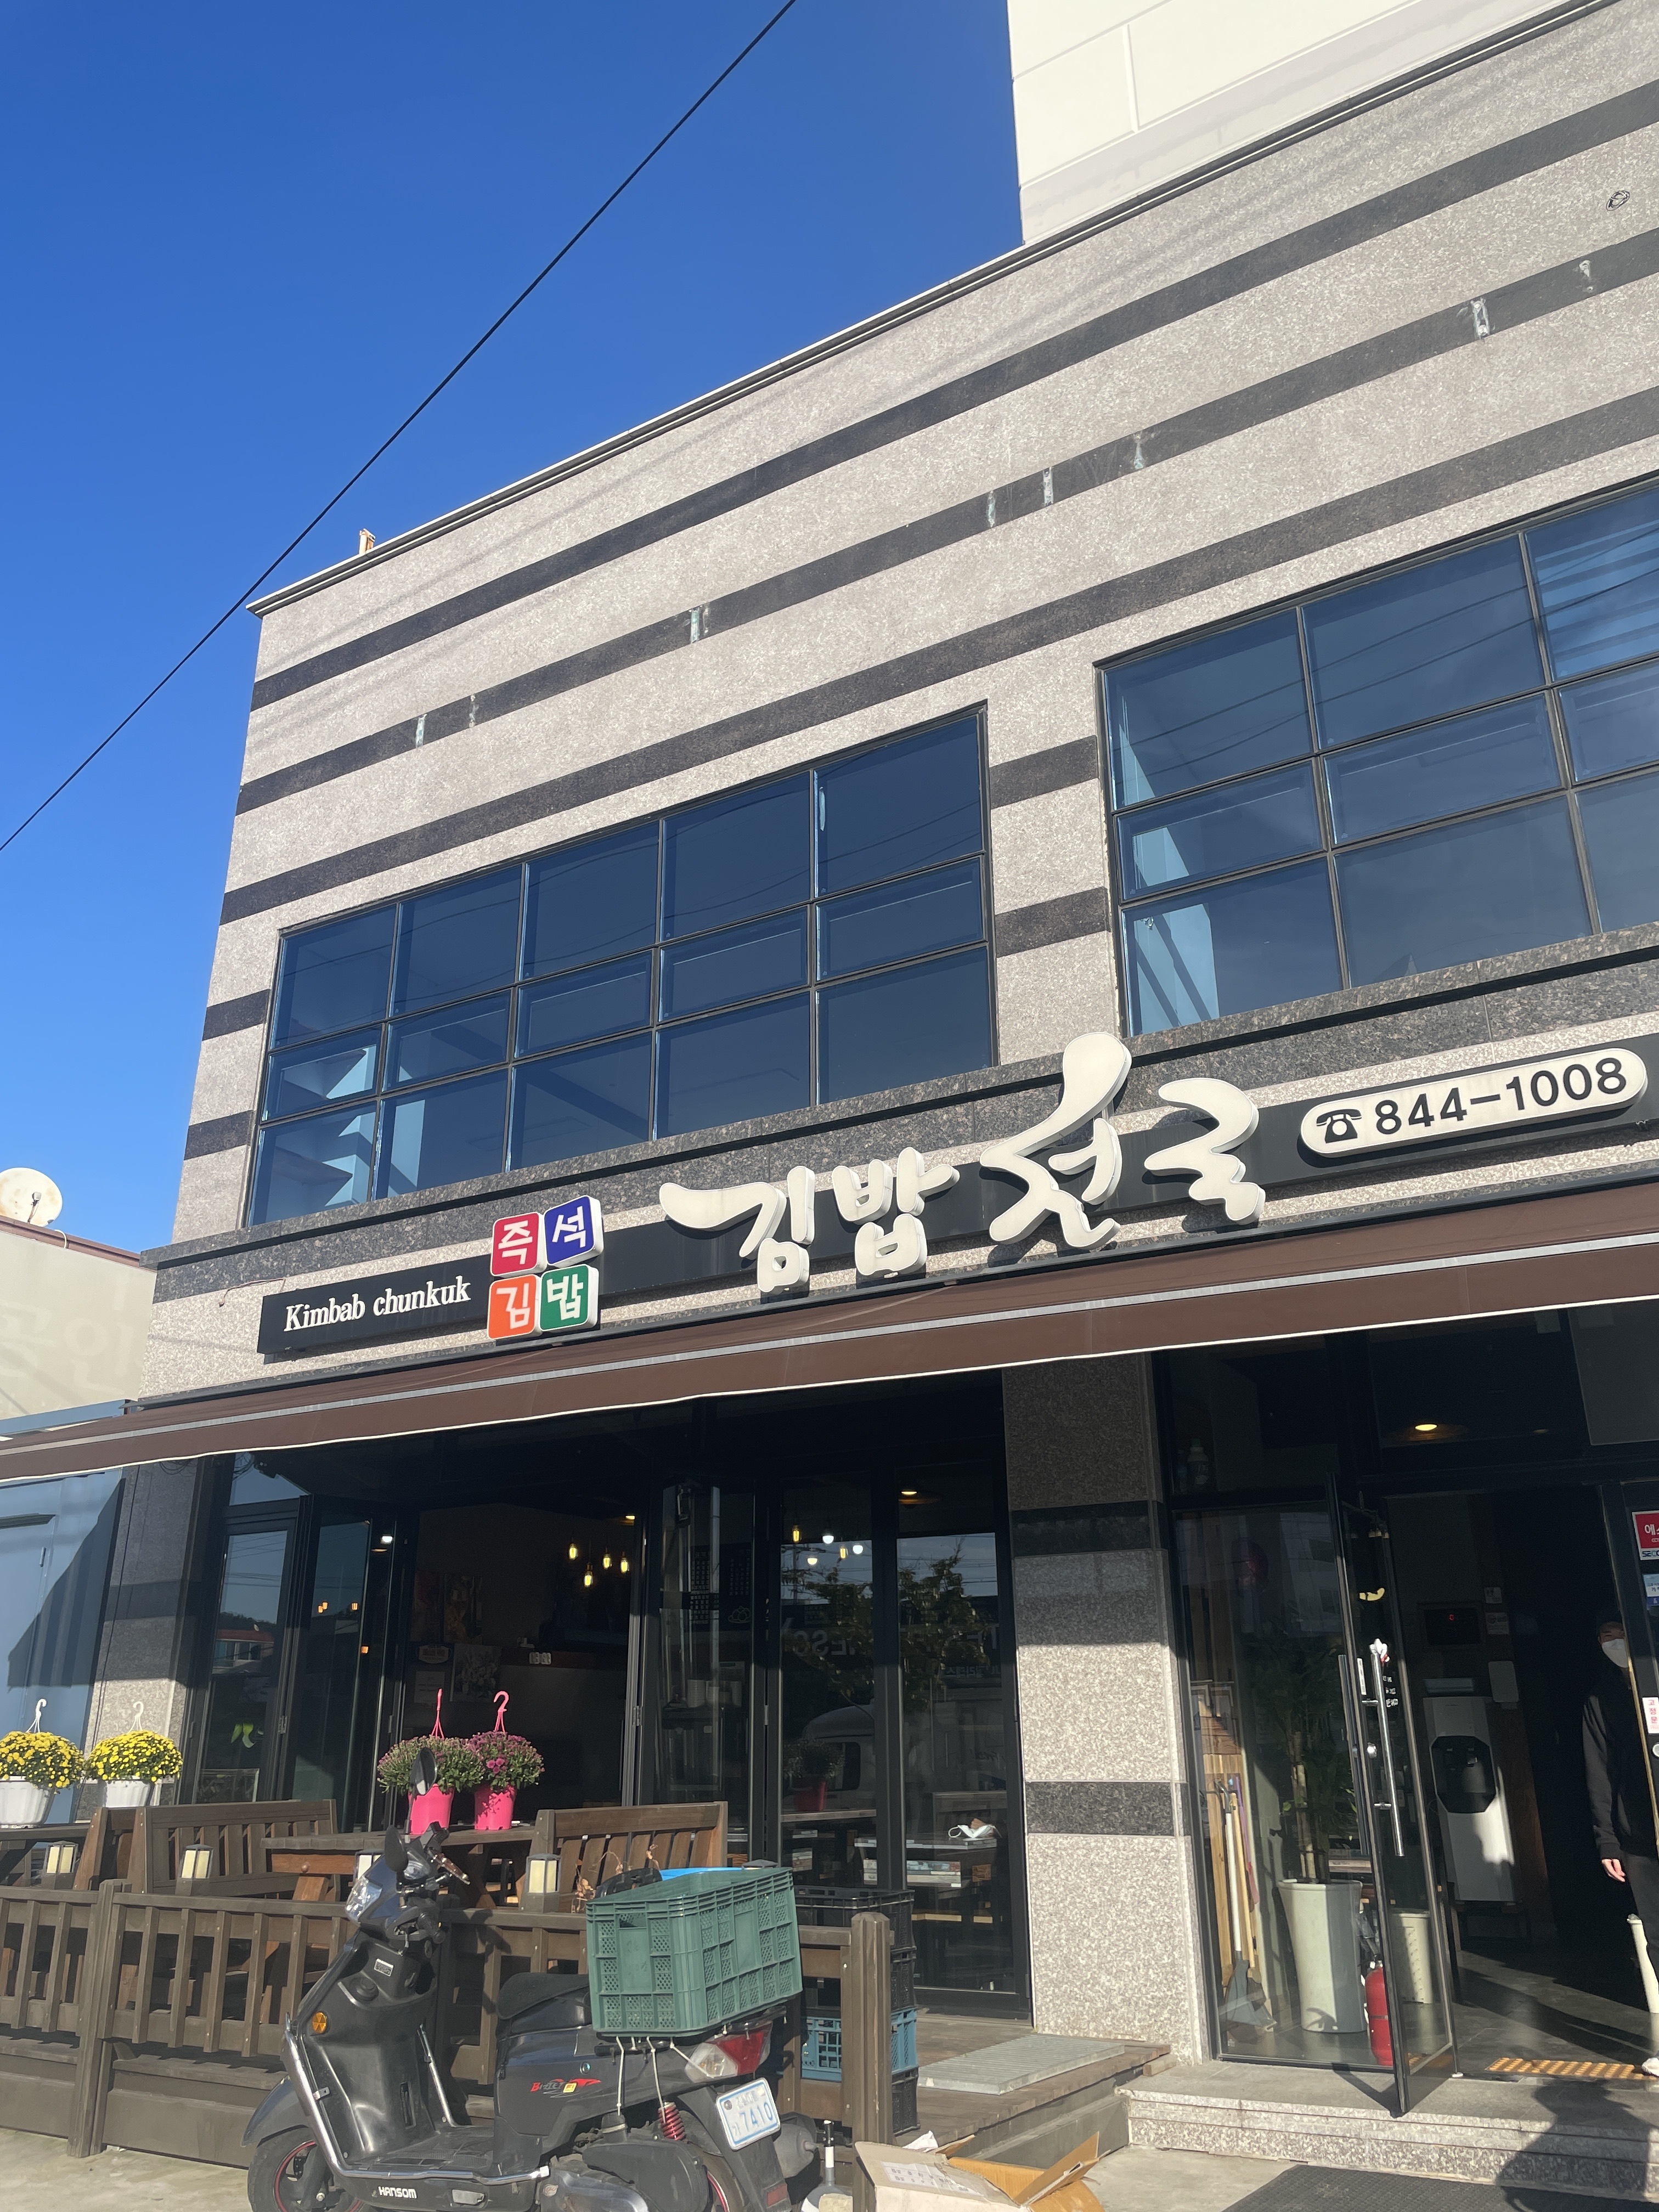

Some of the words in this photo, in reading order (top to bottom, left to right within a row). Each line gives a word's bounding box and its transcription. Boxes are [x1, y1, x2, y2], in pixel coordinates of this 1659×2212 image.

[1375, 1057, 1627, 1135] 844-1008
[498, 1206, 586, 1264] 즉석
[283, 1294, 365, 1331] Kimbab
[373, 1276, 471, 1316] chunkuk
[496, 1274, 583, 1329] 김밥
[740, 2102, 773, 2132] 7410
[378, 2186, 417, 2199] HANSOM
